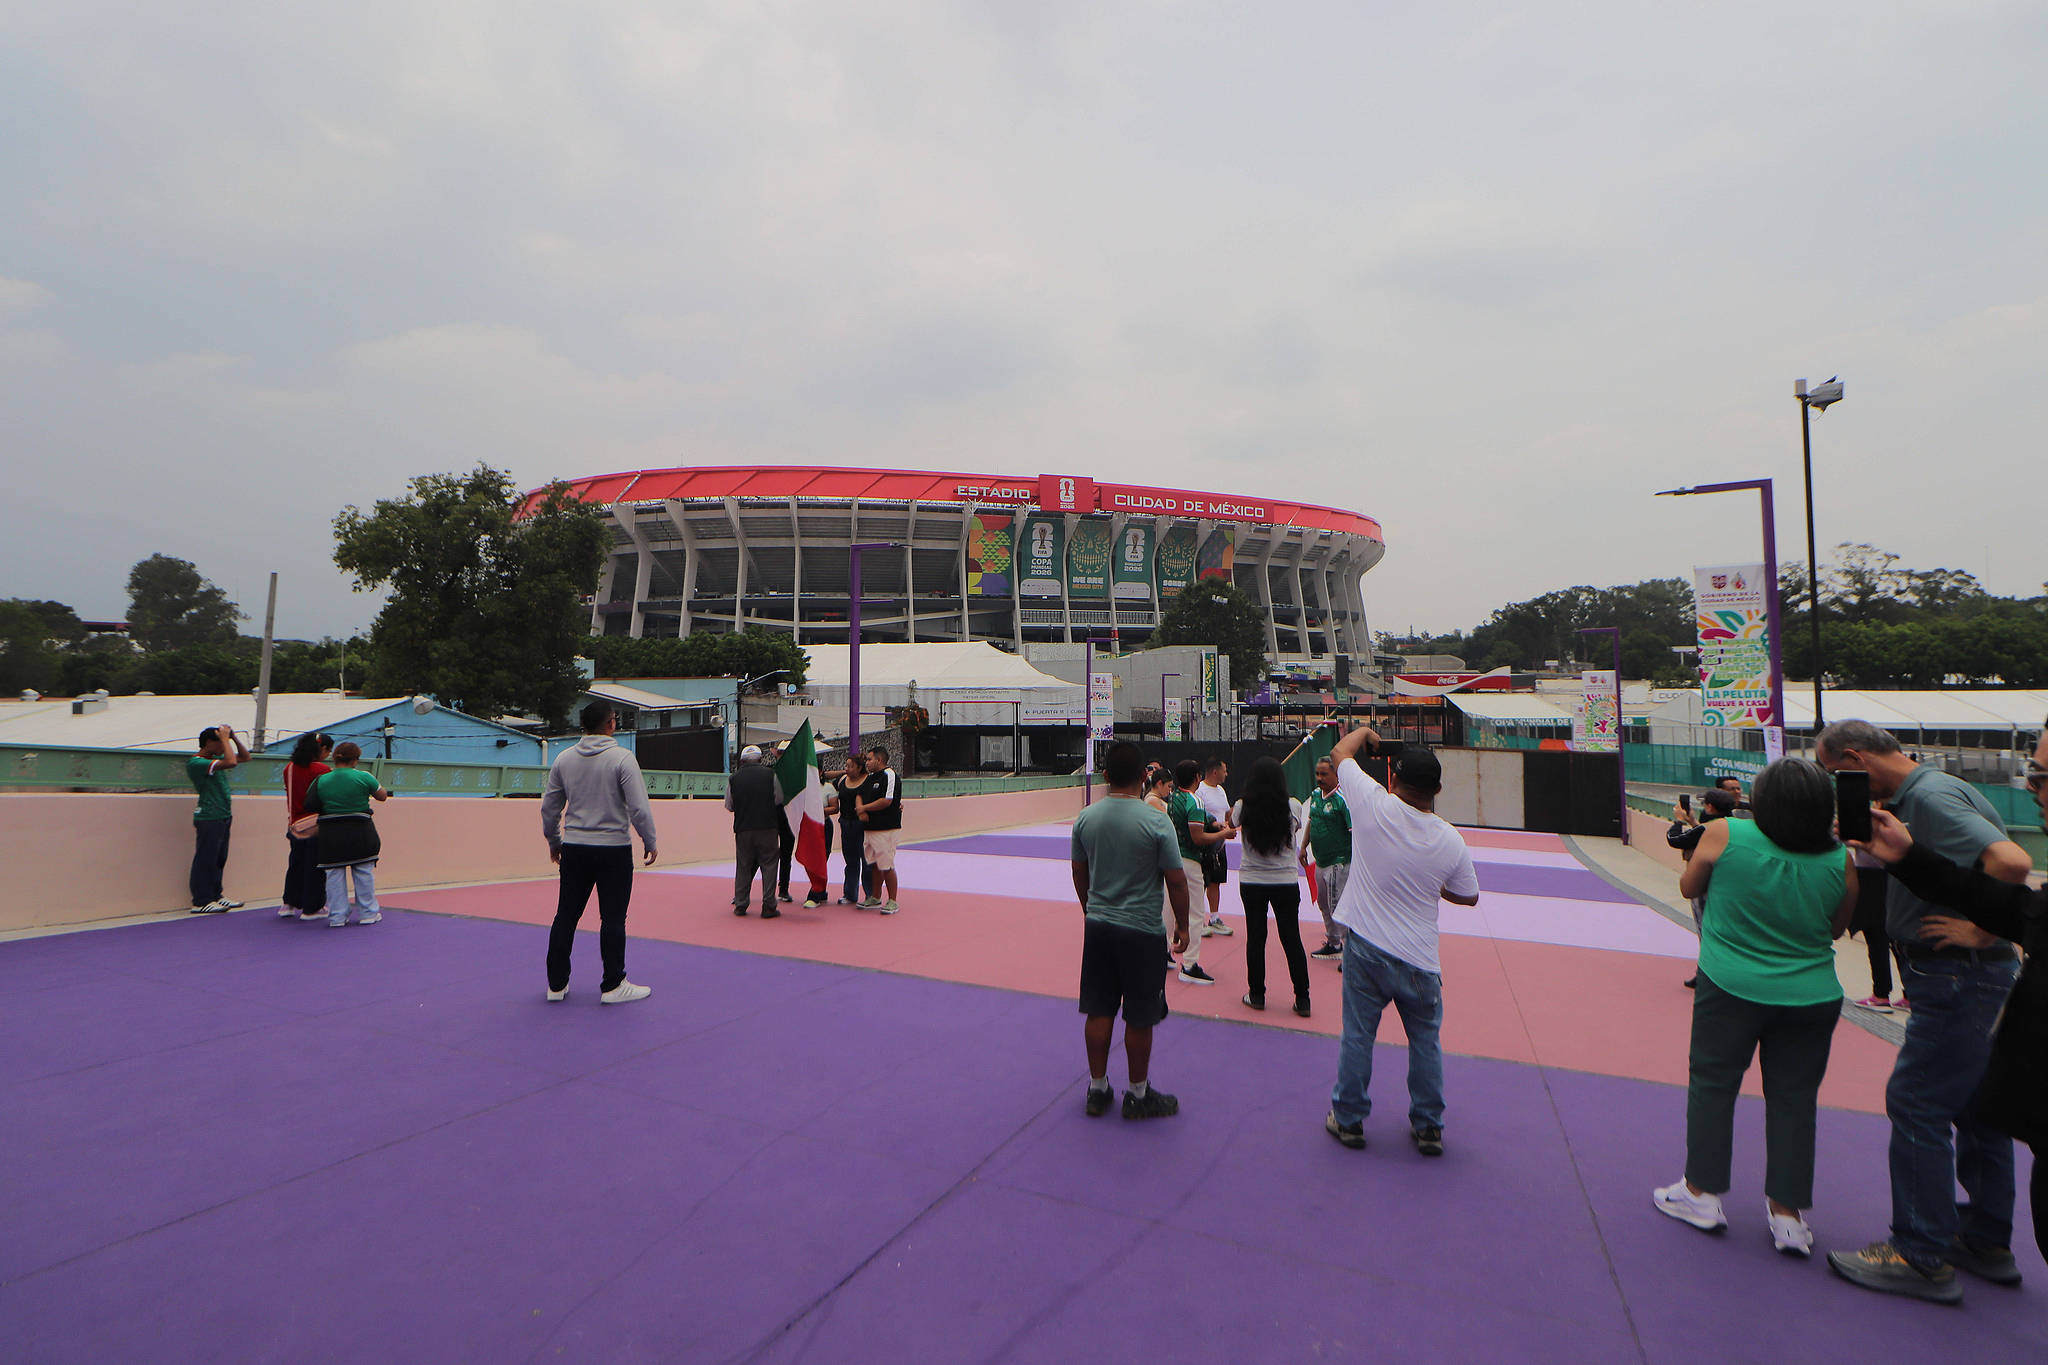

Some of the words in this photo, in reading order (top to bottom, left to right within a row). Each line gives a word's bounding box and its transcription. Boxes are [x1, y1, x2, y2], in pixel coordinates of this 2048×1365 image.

[957, 485, 1031, 499] ESTADIO
[1114, 494, 1177, 510] CIUDAD
[1183, 500, 1204, 513] DE
[1209, 502, 1265, 518] MÉXICO
[1031, 558, 1052, 566] COPA
[1437, 675, 1459, 685] Coca-Cola
[1706, 690, 1720, 699] LA
[1723, 689, 1767, 698] PELOTA
[1711, 757, 1733, 768] COPA
[1704, 767, 1719, 776] DE
